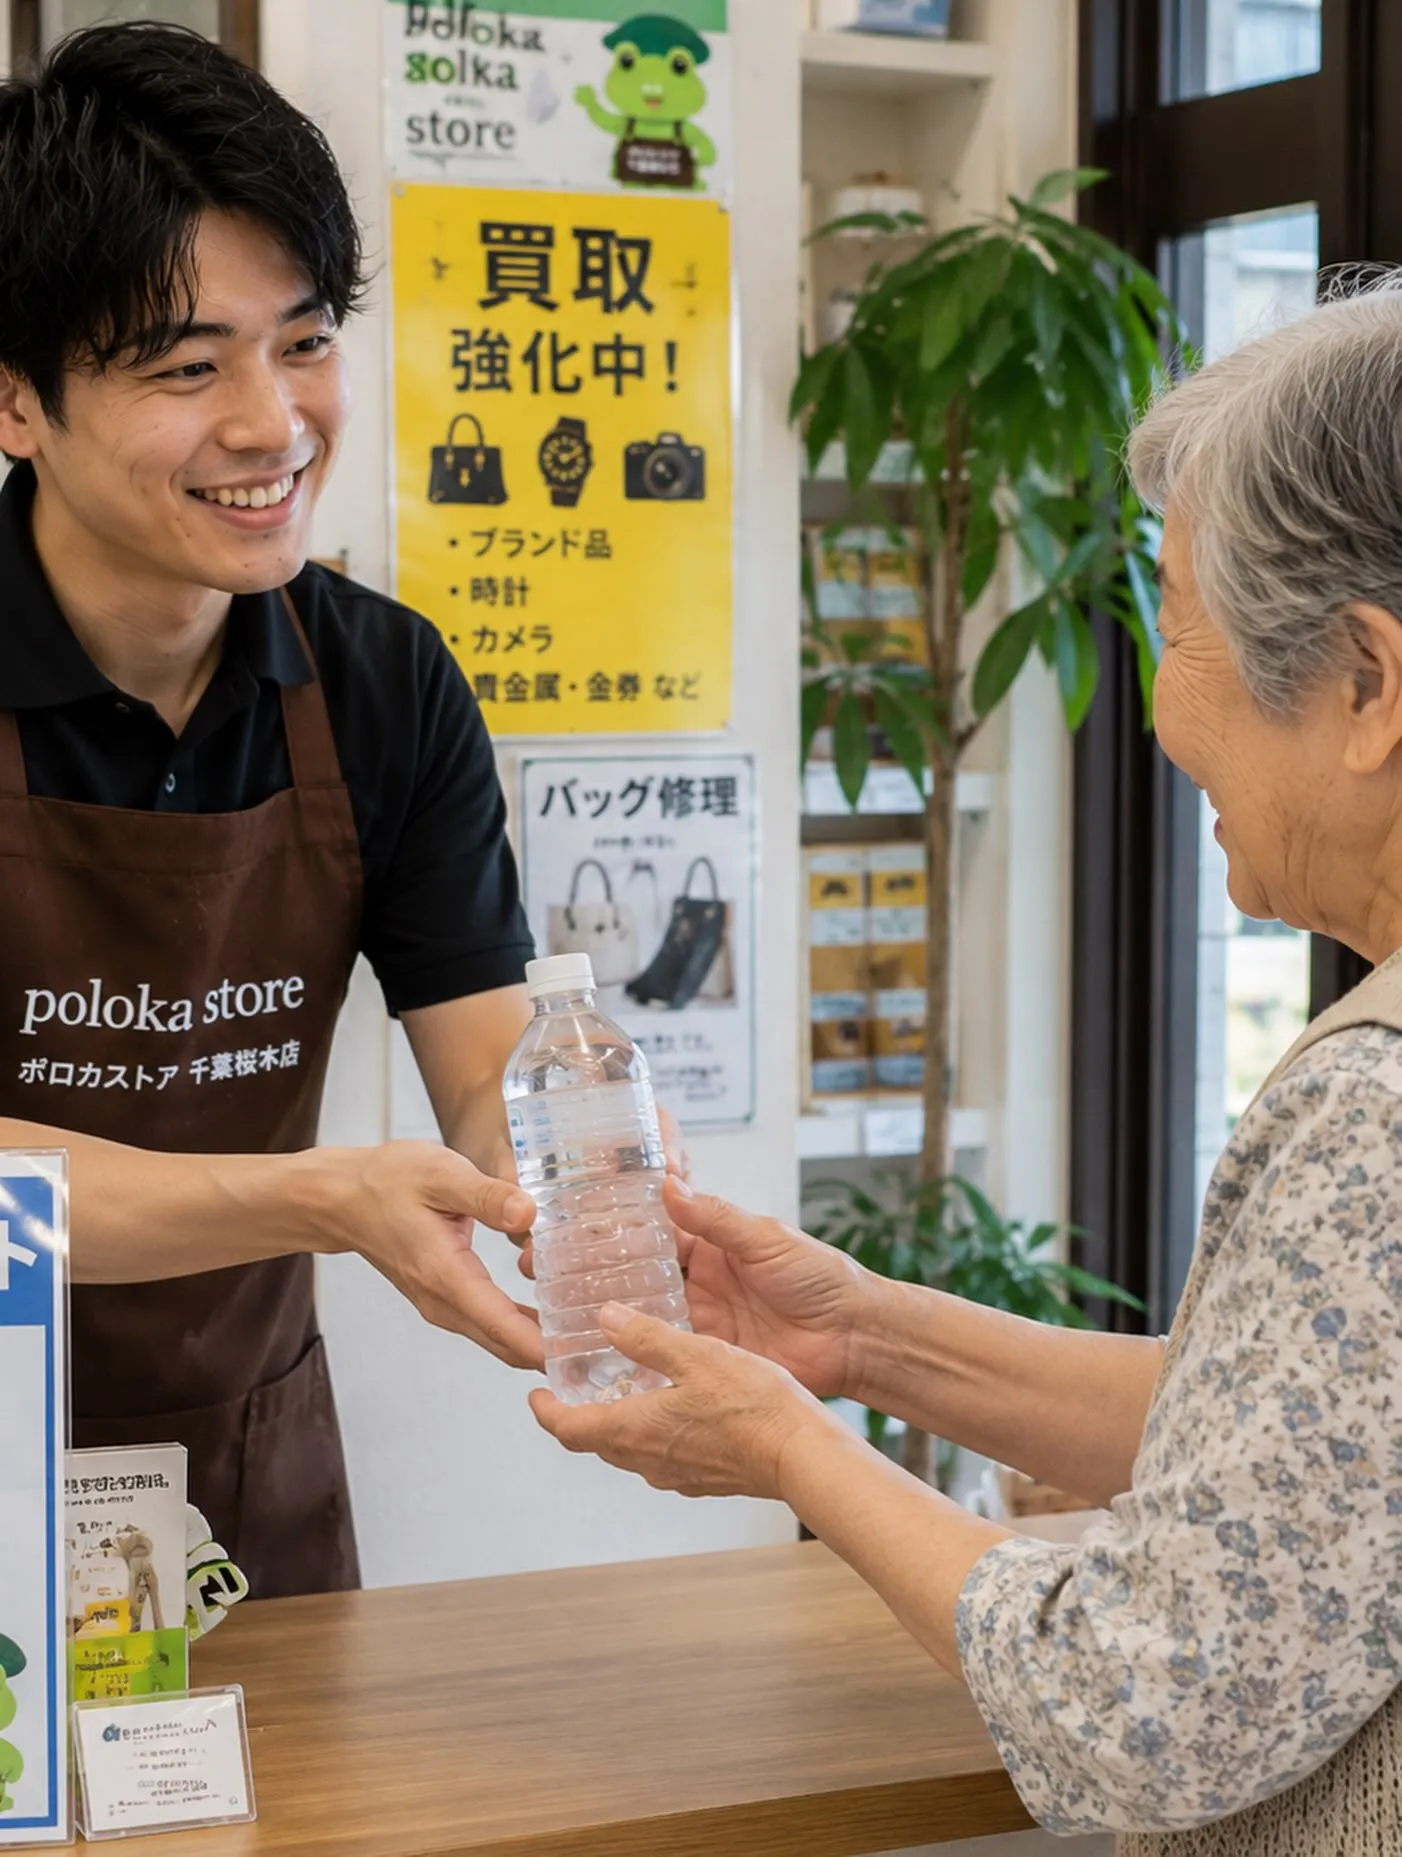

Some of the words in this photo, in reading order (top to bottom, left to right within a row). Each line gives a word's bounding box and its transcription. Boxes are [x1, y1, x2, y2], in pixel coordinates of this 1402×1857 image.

[405, 109, 516, 150] store
[478, 221, 654, 315] 買取
[450, 328, 678, 397] 強化中！
[540, 775, 739, 819] バッグ修理
[19, 978, 193, 1035] poloka
[202, 975, 304, 1024] store
[18, 1057, 179, 1091] ポロカストア
[189, 1039, 301, 1085] 千葉桜木店
